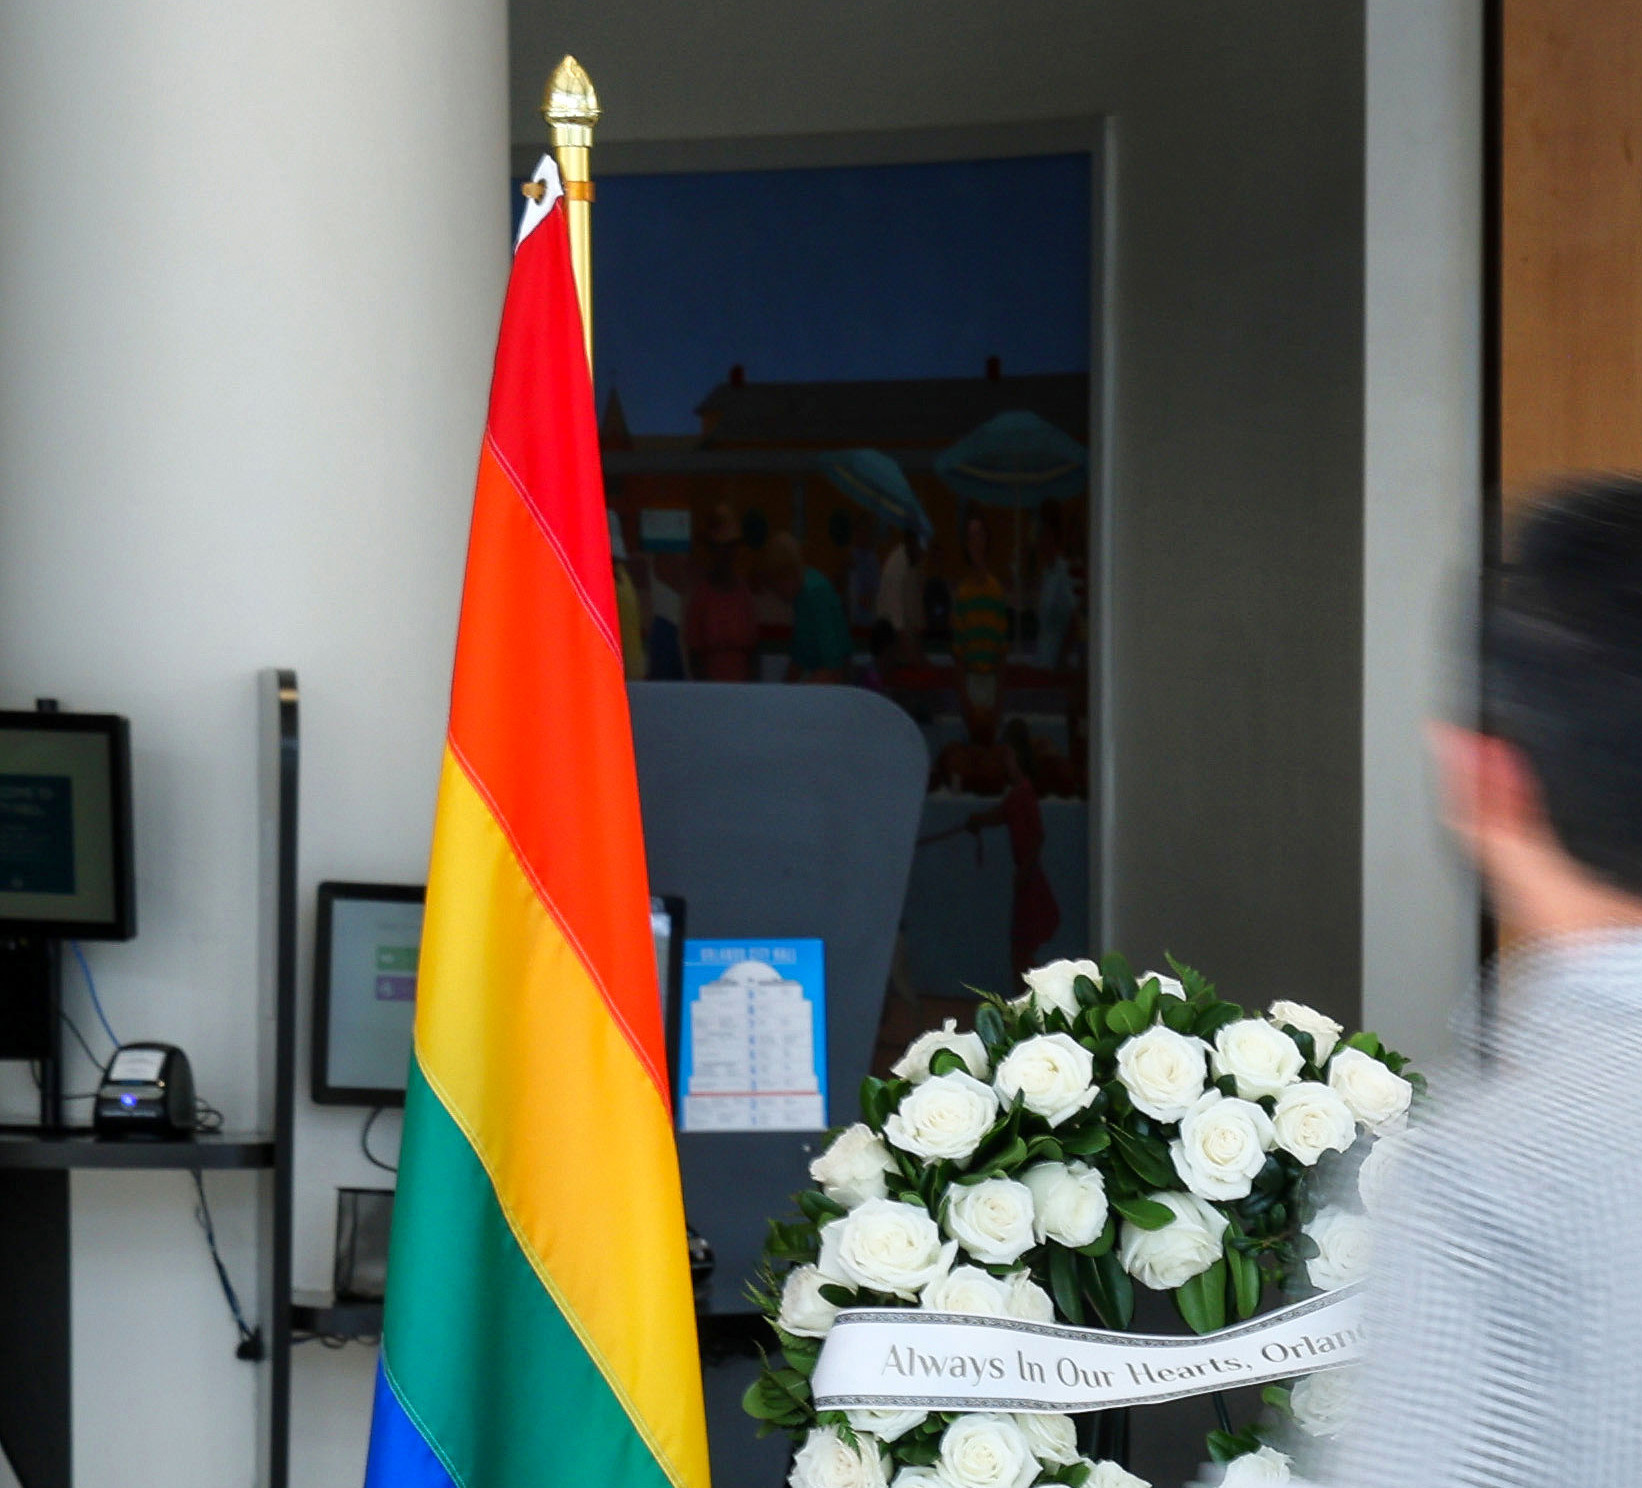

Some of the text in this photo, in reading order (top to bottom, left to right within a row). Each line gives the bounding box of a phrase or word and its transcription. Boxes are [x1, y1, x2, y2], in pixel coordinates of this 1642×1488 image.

[881, 1343, 1005, 1387] Always
[1017, 1349, 1046, 1384] In
[1056, 1356, 1115, 1388] Our
[1125, 1356, 1254, 1387] Hearts,
